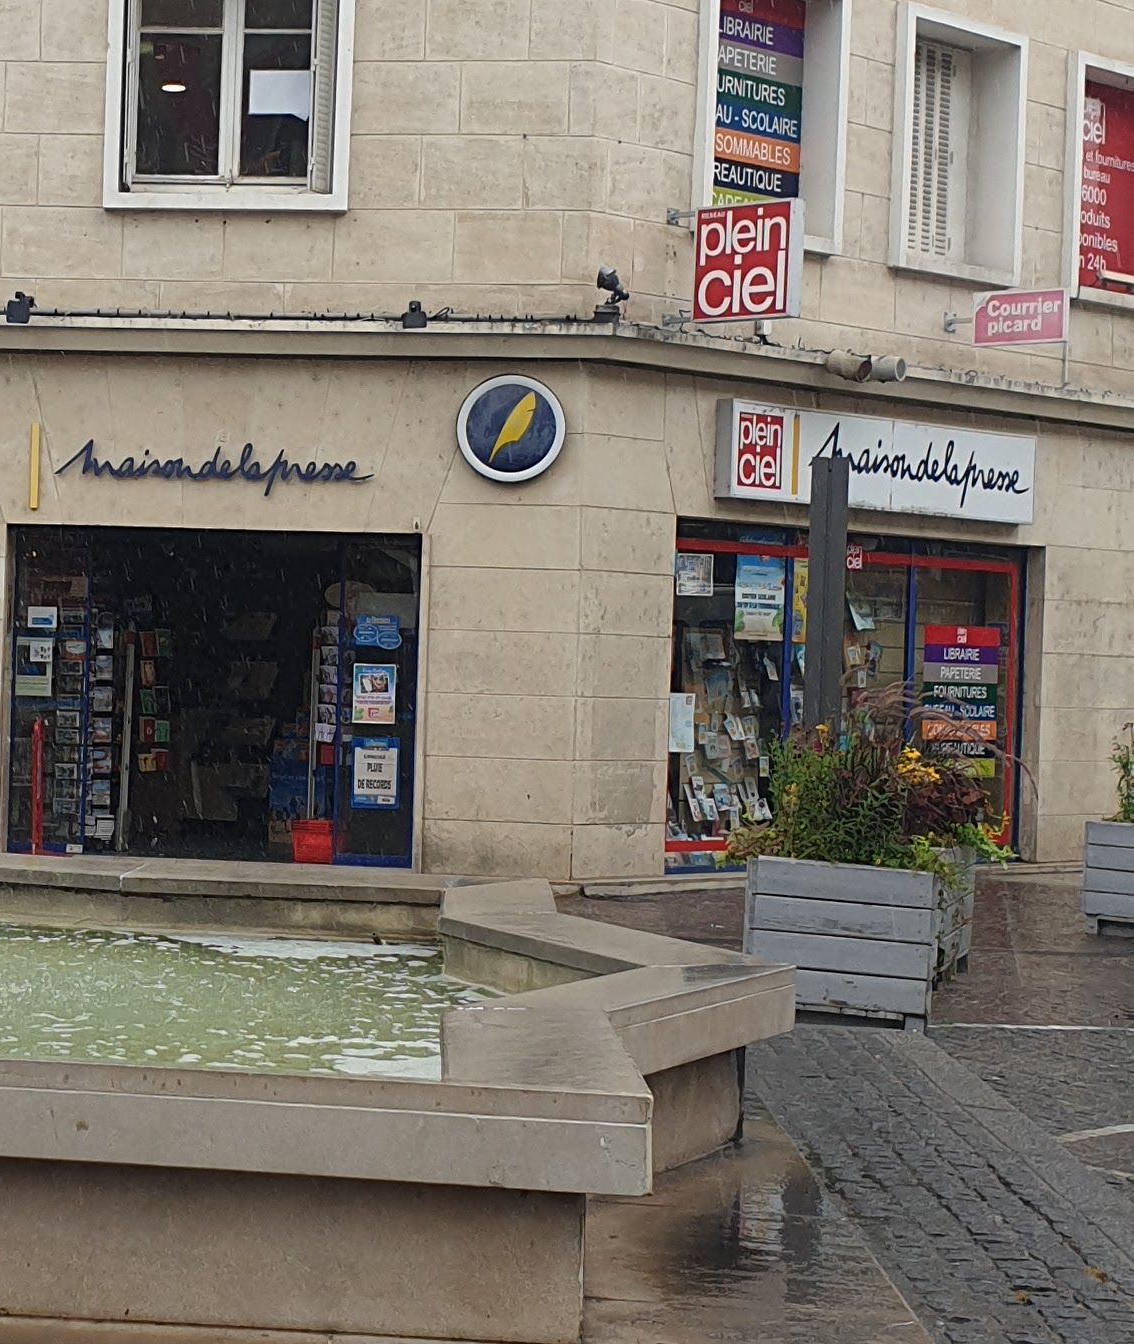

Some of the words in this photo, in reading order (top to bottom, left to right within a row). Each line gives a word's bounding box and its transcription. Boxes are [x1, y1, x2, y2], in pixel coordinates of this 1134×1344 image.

[718, 45, 777, 75] APETERIE
[717, 74, 785, 106] URNITURES
[742, 108, 798, 138] SCOLAIRE
[716, 133, 791, 165] SOMMABLES
[714, 162, 782, 192] REAUTIQUE
[1083, 165, 1111, 184] bureau
[1081, 184, 1107, 206] 6000
[1080, 209, 1111, 229] oduits
[700, 207, 787, 266] plein
[1078, 233, 1118, 253] ponibles
[698, 250, 786, 316] ciel
[987, 297, 1061, 317] Courrier
[987, 314, 1042, 336] picard
[739, 415, 782, 449] plein
[739, 444, 782, 487] ciel
[943, 647, 980, 661] LIBRAIRIE
[940, 667, 982, 680] PAPETERIE
[933, 685, 987, 699] FOURNITURES
